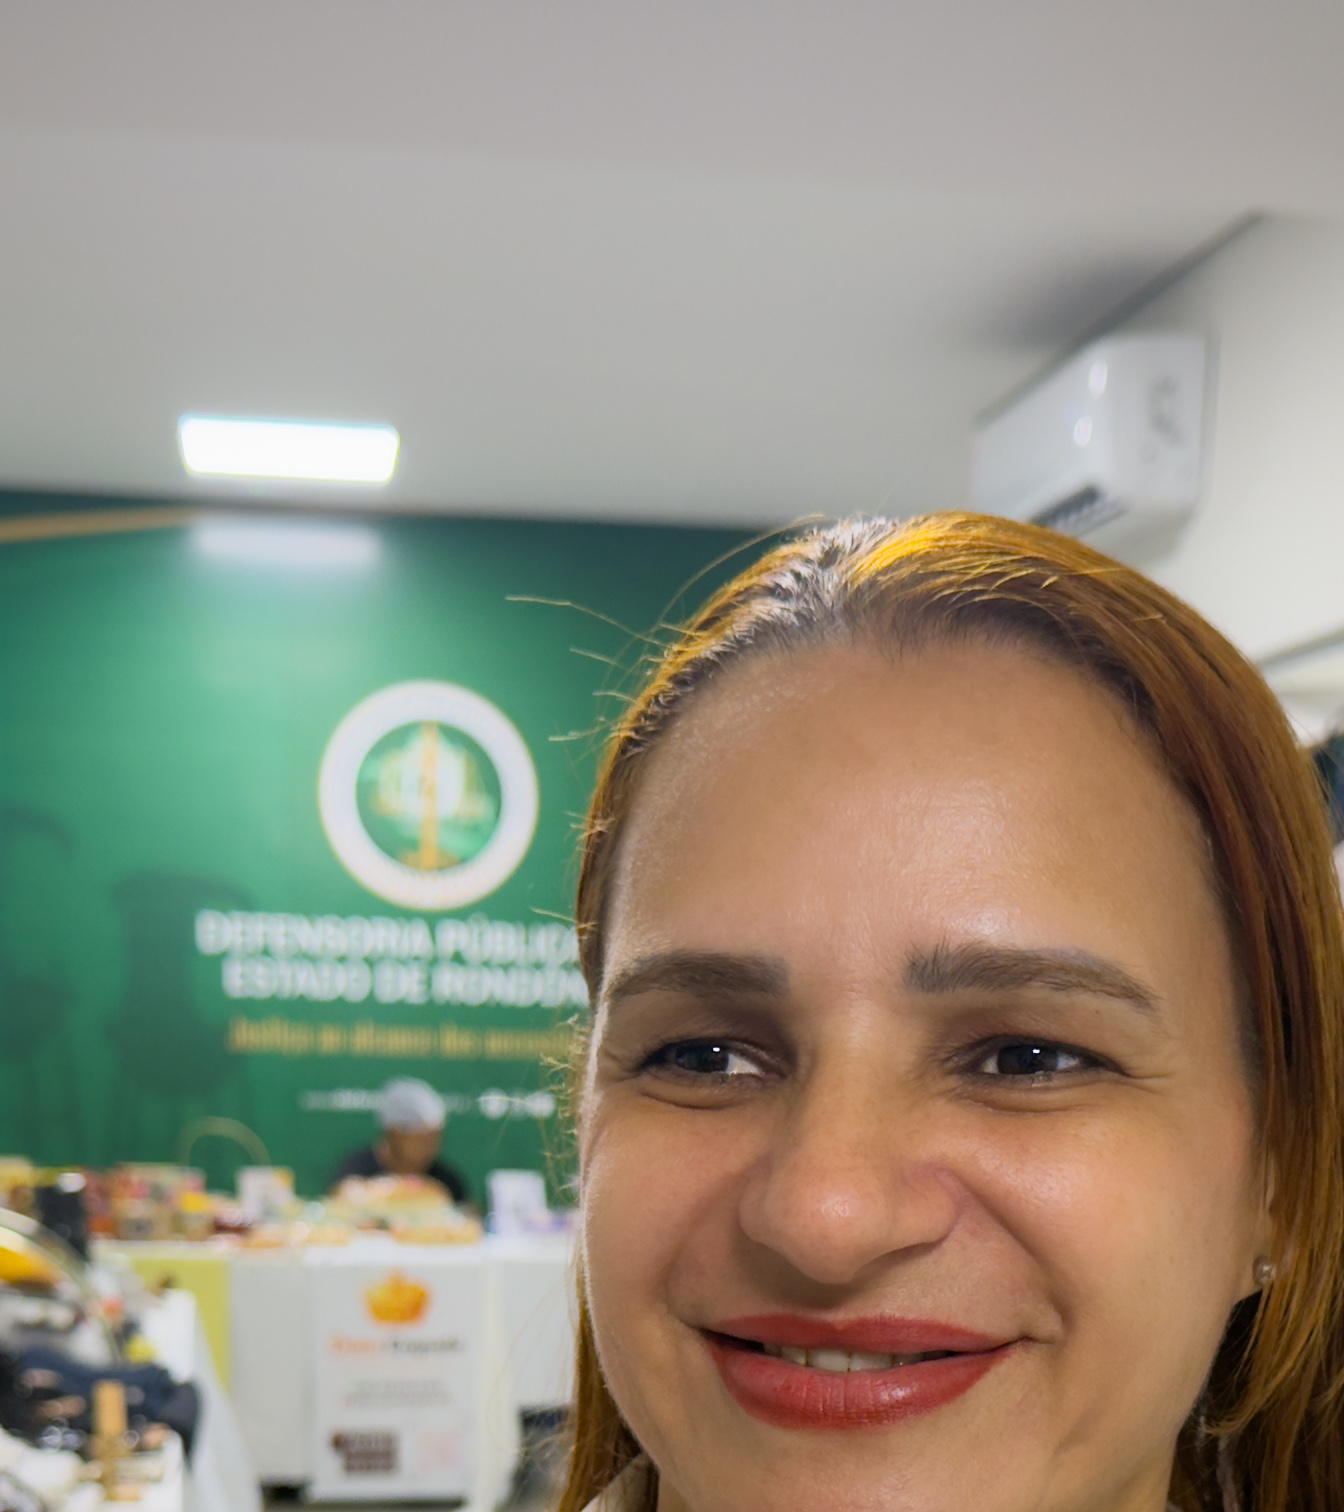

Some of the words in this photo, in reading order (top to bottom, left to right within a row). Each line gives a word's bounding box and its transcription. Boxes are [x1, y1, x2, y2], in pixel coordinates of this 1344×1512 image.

[197, 912, 433, 957] DEFENSORIA
[225, 957, 370, 999] ESTADO
[376, 962, 427, 1002] DE
